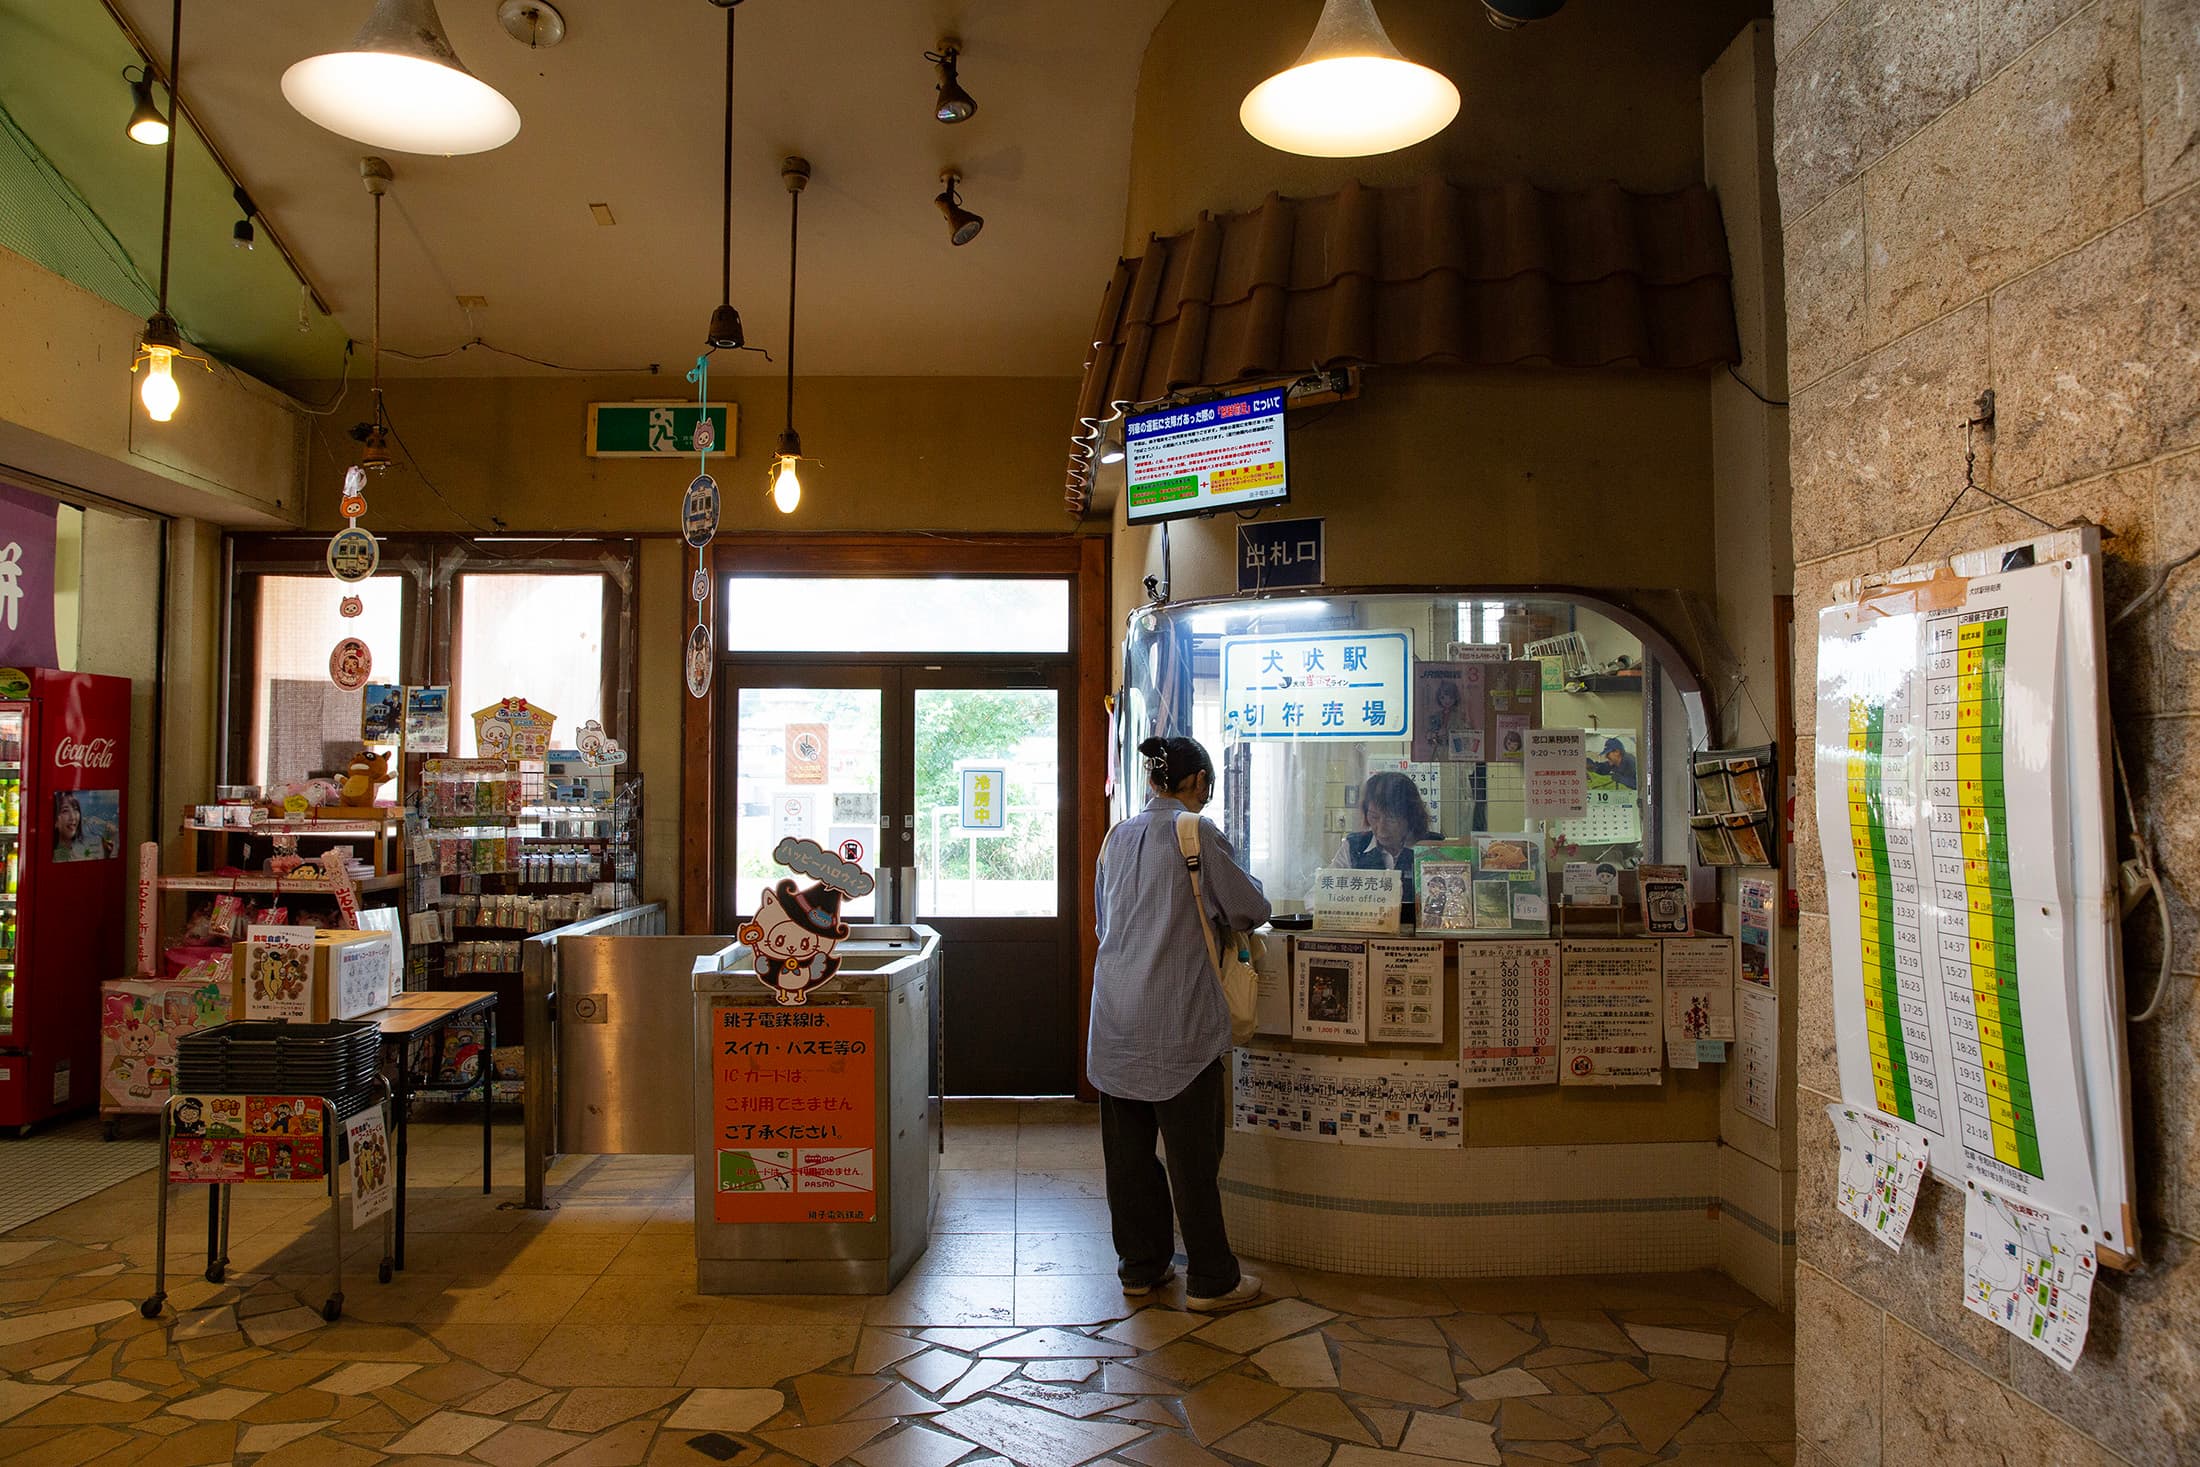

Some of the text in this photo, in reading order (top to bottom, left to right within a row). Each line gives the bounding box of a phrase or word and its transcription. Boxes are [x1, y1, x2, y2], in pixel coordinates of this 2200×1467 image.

[1253, 396, 1280, 412] について
[1246, 541, 1316, 568] 出札口
[1262, 646, 1368, 673] 犬吠駅
[1934, 685, 1950, 695] 6:54
[1244, 700, 1386, 727] 切符売場
[1889, 710, 1950, 723] 7:11 7:19
[1532, 735, 1580, 744] 窓口業務時間
[1888, 736, 1950, 748] 7:36 7:45
[1398, 760, 1408, 769] 10
[1598, 793, 1608, 801] 10
[1934, 787, 1951, 797] 8:42
[1889, 835, 1957, 849] 10:20 10:42
[782, 846, 867, 889] ハッピーハロウィン
[1893, 858, 1959, 874] 11:35 11:47
[1321, 876, 1393, 892] 乗車券売場
[1896, 882, 1963, 901] 12:40 12:48
[1328, 894, 1386, 903] Ticket office
[1896, 907, 1964, 926] 13:32 13:44
[1898, 931, 1916, 943] 14:28
[1943, 940, 1965, 952] 14:37
[1500, 959, 1551, 968] 大人 小児
[1899, 955, 1918, 968] 15:19
[1946, 966, 1967, 978] 15:27
[1502, 968, 1519, 977] 350
[1534, 968, 1550, 976] 180
[1502, 979, 1519, 987] 300
[1502, 989, 1519, 997] 300
[1900, 979, 1970, 1004] 16:23 16:44
[1502, 999, 1519, 1007] 270
[724, 1012, 832, 1028] 銚子電鉄線は、
[1502, 1009, 1519, 1017] 240
[1903, 1002, 1923, 1017] 17:25
[1953, 1016, 1974, 1030] 17:35
[1502, 1018, 1519, 1026] 240
[1502, 1028, 1519, 1036] 210
[724, 1040, 866, 1056] スイカ・パスモ等の
[1906, 1027, 1977, 1057] 18:16 18:26
[1910, 1050, 1981, 1082] 19:07 19:15
[1913, 1074, 1934, 1089] 19:58
[1962, 1092, 1984, 1108] 20:13
[1917, 1104, 1937, 1119] 21:05
[1966, 1124, 1988, 1141] 21:18
[724, 1124, 844, 1140] ご了承ください。
[808, 1210, 864, 1220] 銚子電気鉄道
